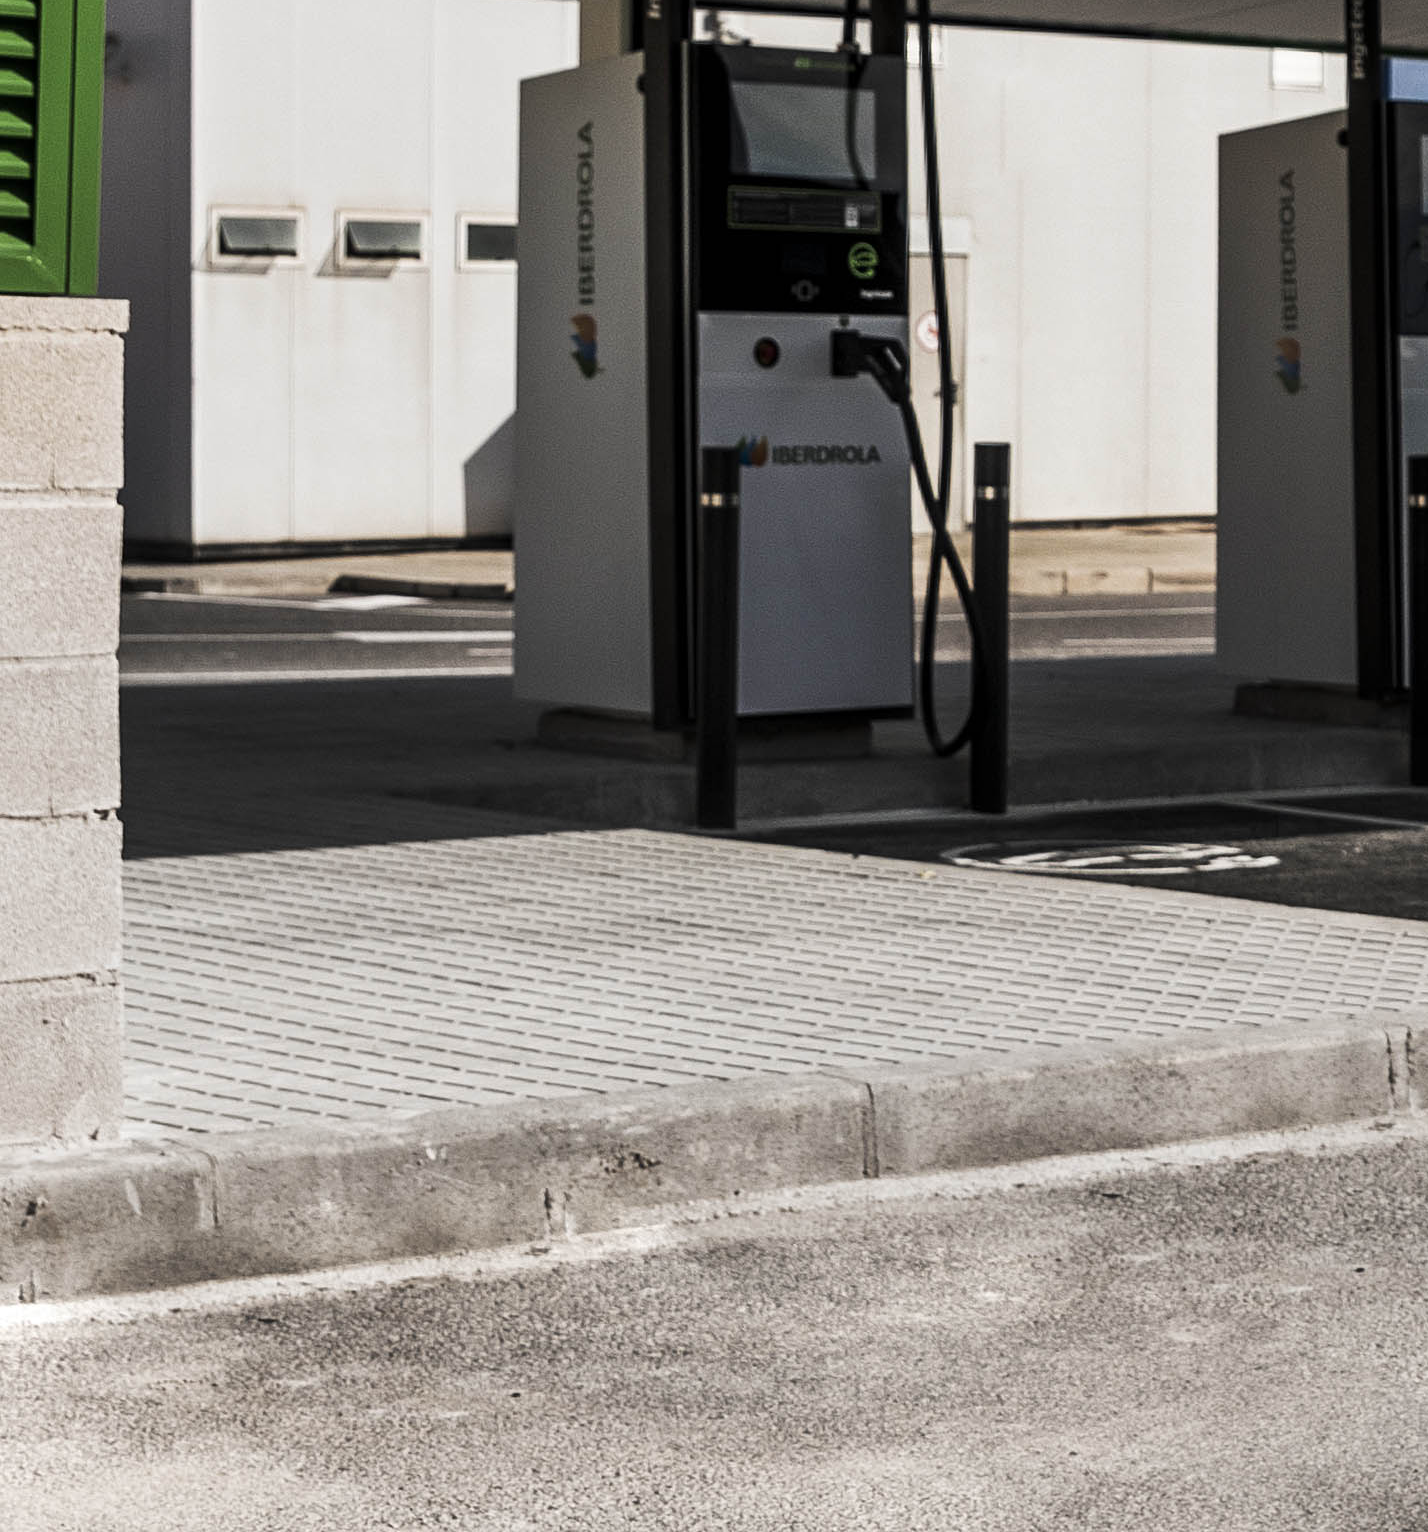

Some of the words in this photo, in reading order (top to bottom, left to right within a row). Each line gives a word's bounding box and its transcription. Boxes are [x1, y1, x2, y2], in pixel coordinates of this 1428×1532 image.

[577, 122, 594, 305] IBERDROLA
[1280, 169, 1297, 331] IBERDROLA
[772, 444, 881, 465] IBERDROLA
